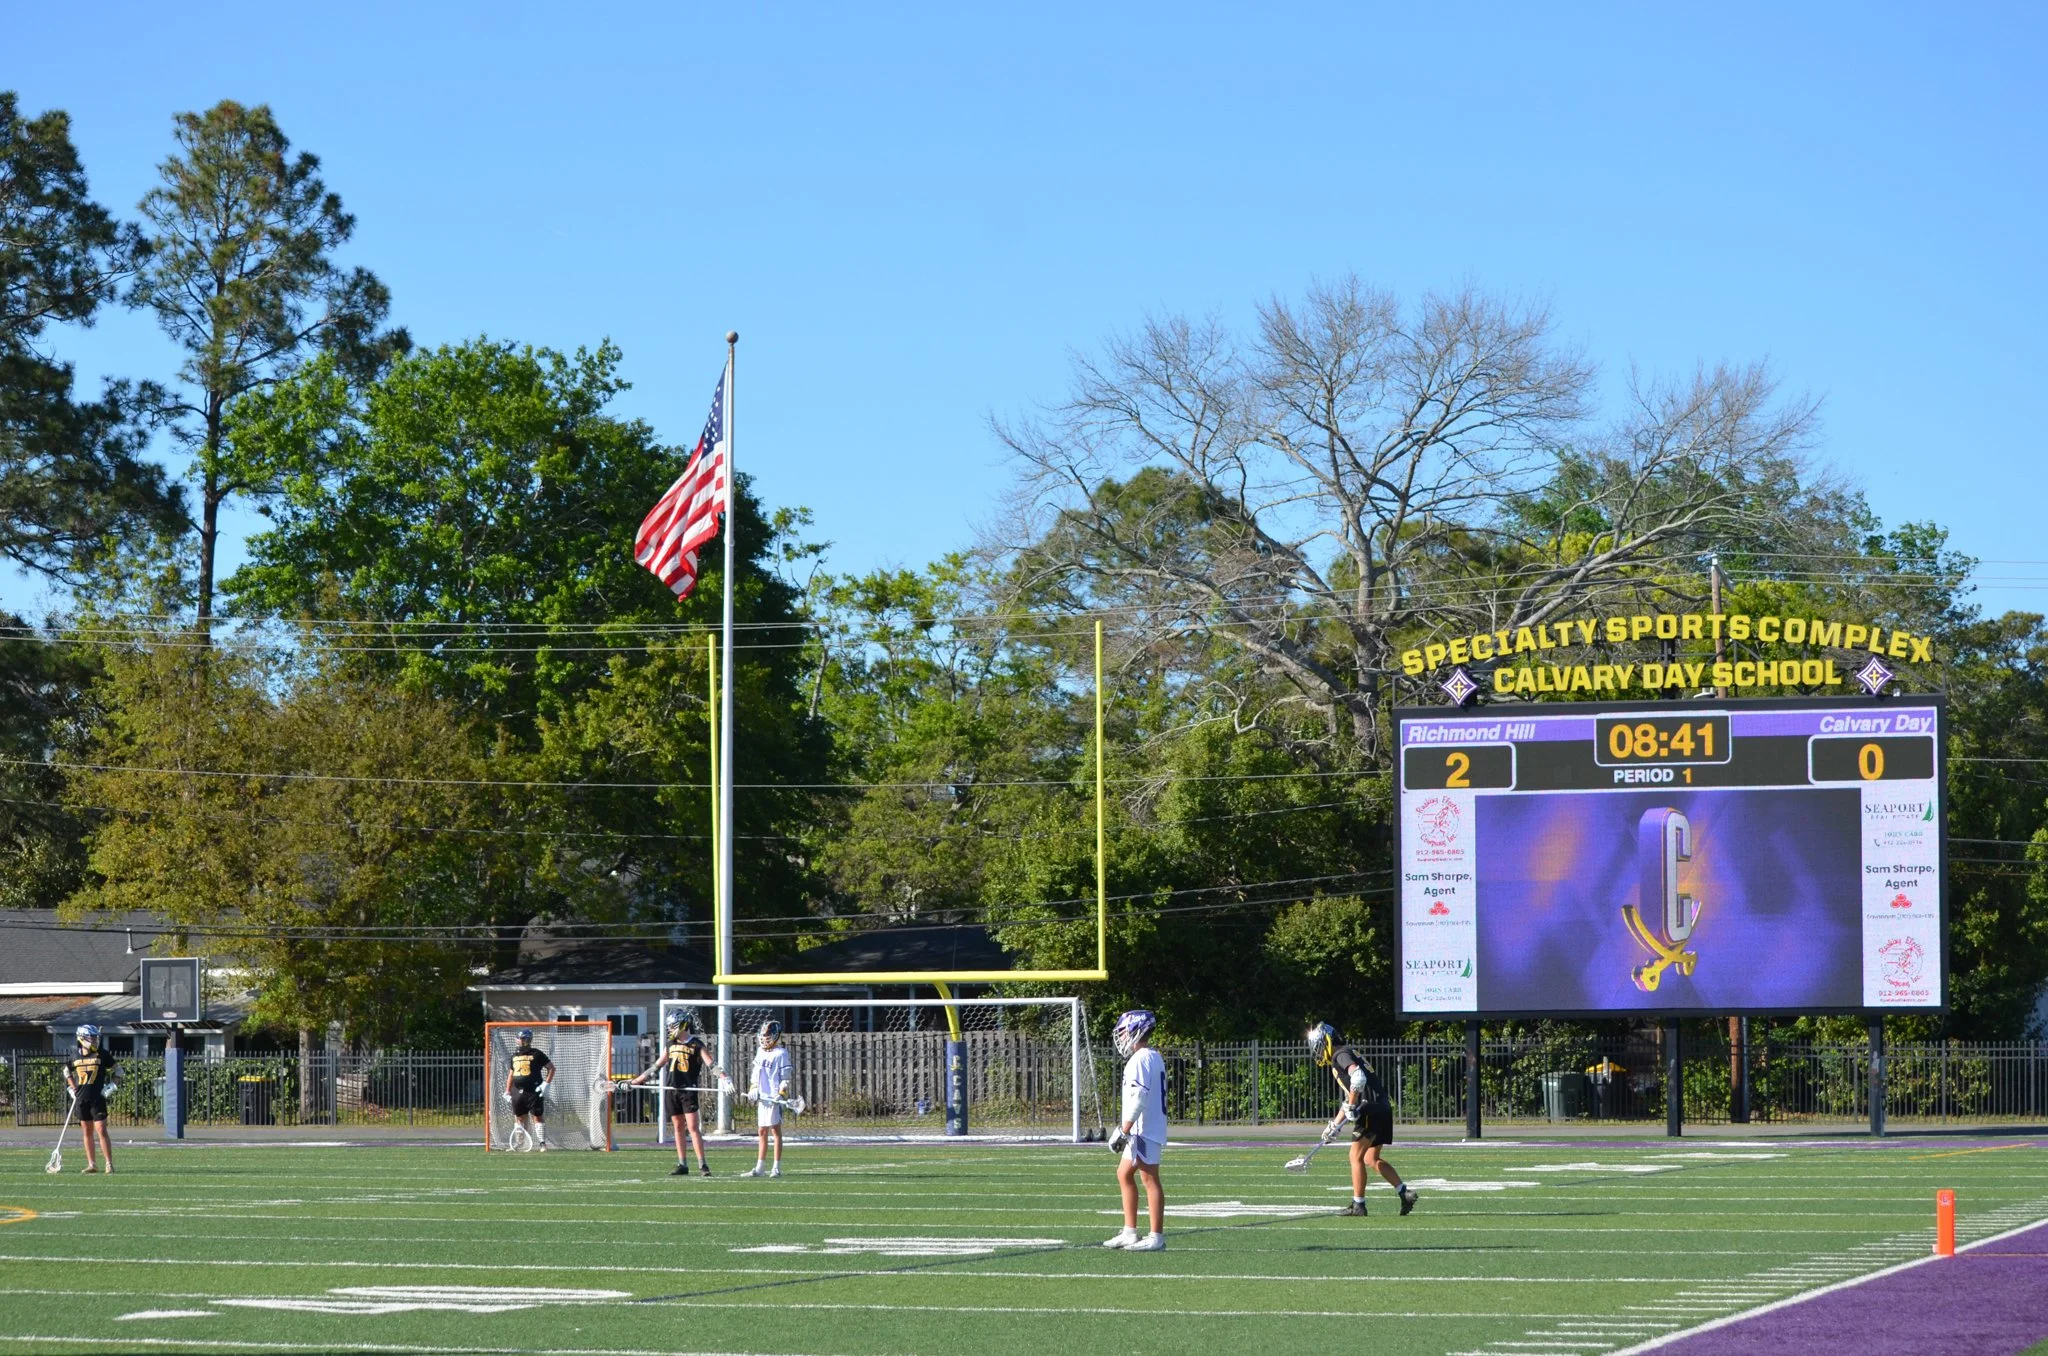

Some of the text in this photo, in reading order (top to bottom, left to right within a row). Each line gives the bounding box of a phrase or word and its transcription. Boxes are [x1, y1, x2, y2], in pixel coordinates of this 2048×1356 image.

[1402, 614, 1932, 675] SPECIALTY SPORTS COMPLEX
[1494, 659, 1842, 693] CALVARY DAY SCHOOL
[1408, 723, 1536, 742] Richmond Hill
[1819, 714, 1933, 735] Calvary Day
[1609, 722, 1714, 759] 08:41
[1445, 752, 1470, 788] 2
[1858, 743, 1885, 781] 0
[1613, 768, 1692, 783] PERIOD 1
[1865, 803, 1924, 813] SEAPORT
[1405, 872, 1472, 882] Sam Sharpe,
[1865, 864, 1935, 875] Sam Sharpe,
[1424, 887, 1455, 897] Agent
[1885, 879, 1918, 889] Agent
[1406, 960, 1463, 969] SEAPORT
[952, 1075, 962, 1129] CAVS
